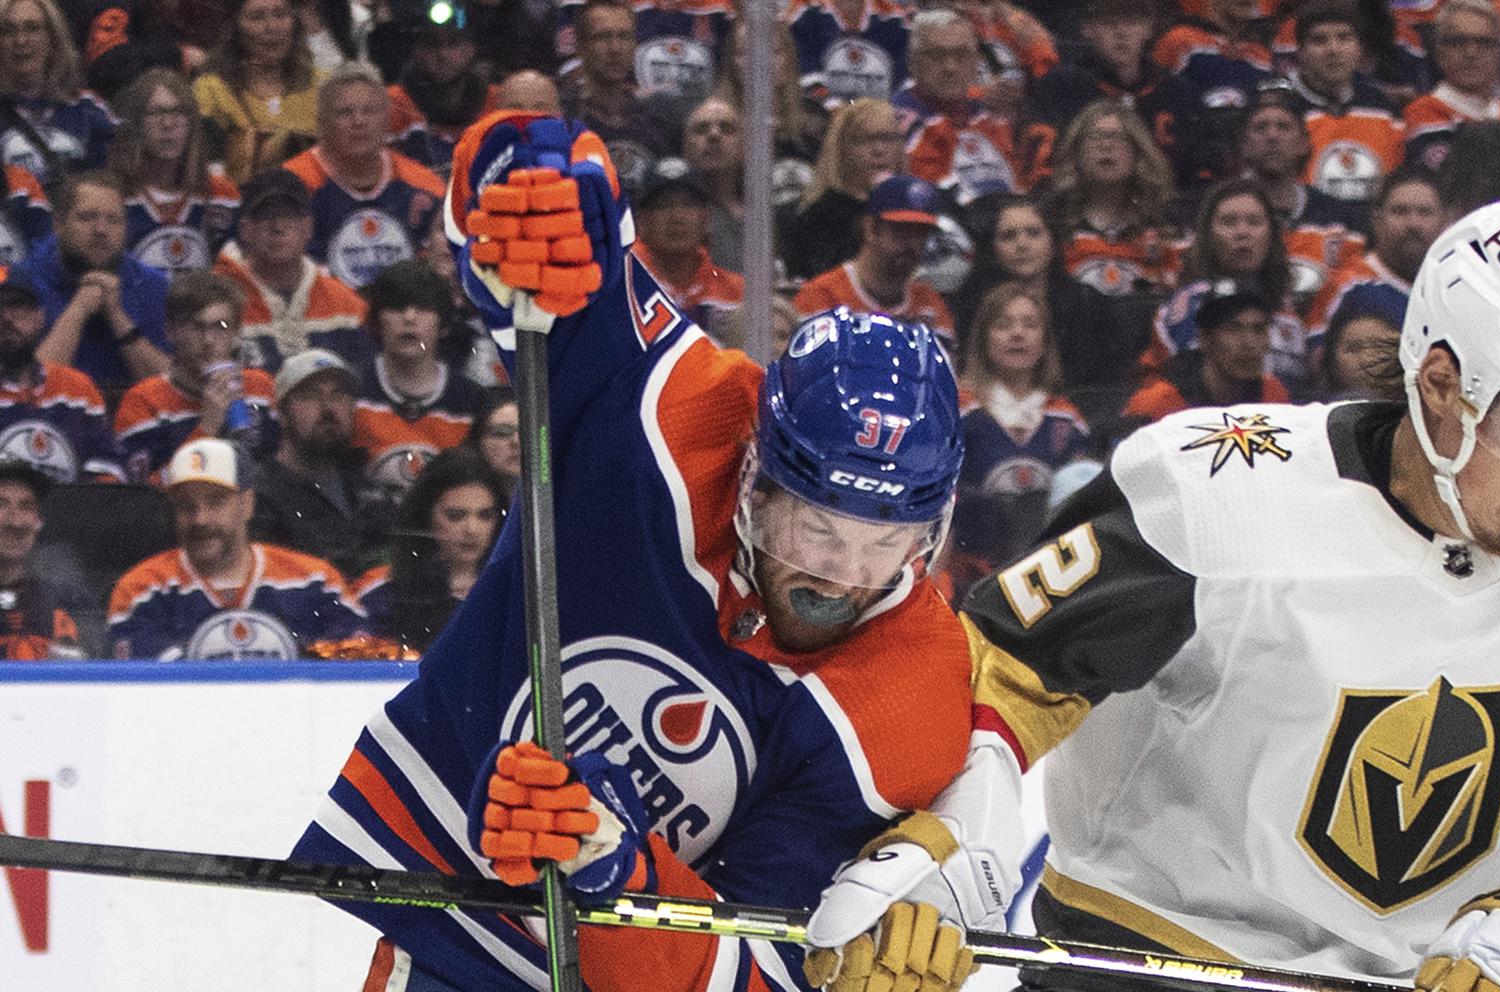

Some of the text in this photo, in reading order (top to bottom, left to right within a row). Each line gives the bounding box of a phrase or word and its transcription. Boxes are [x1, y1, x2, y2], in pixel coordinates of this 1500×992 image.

[855, 407, 910, 454] 37
[829, 470, 905, 496] CCM
[998, 522, 1102, 629] 2
